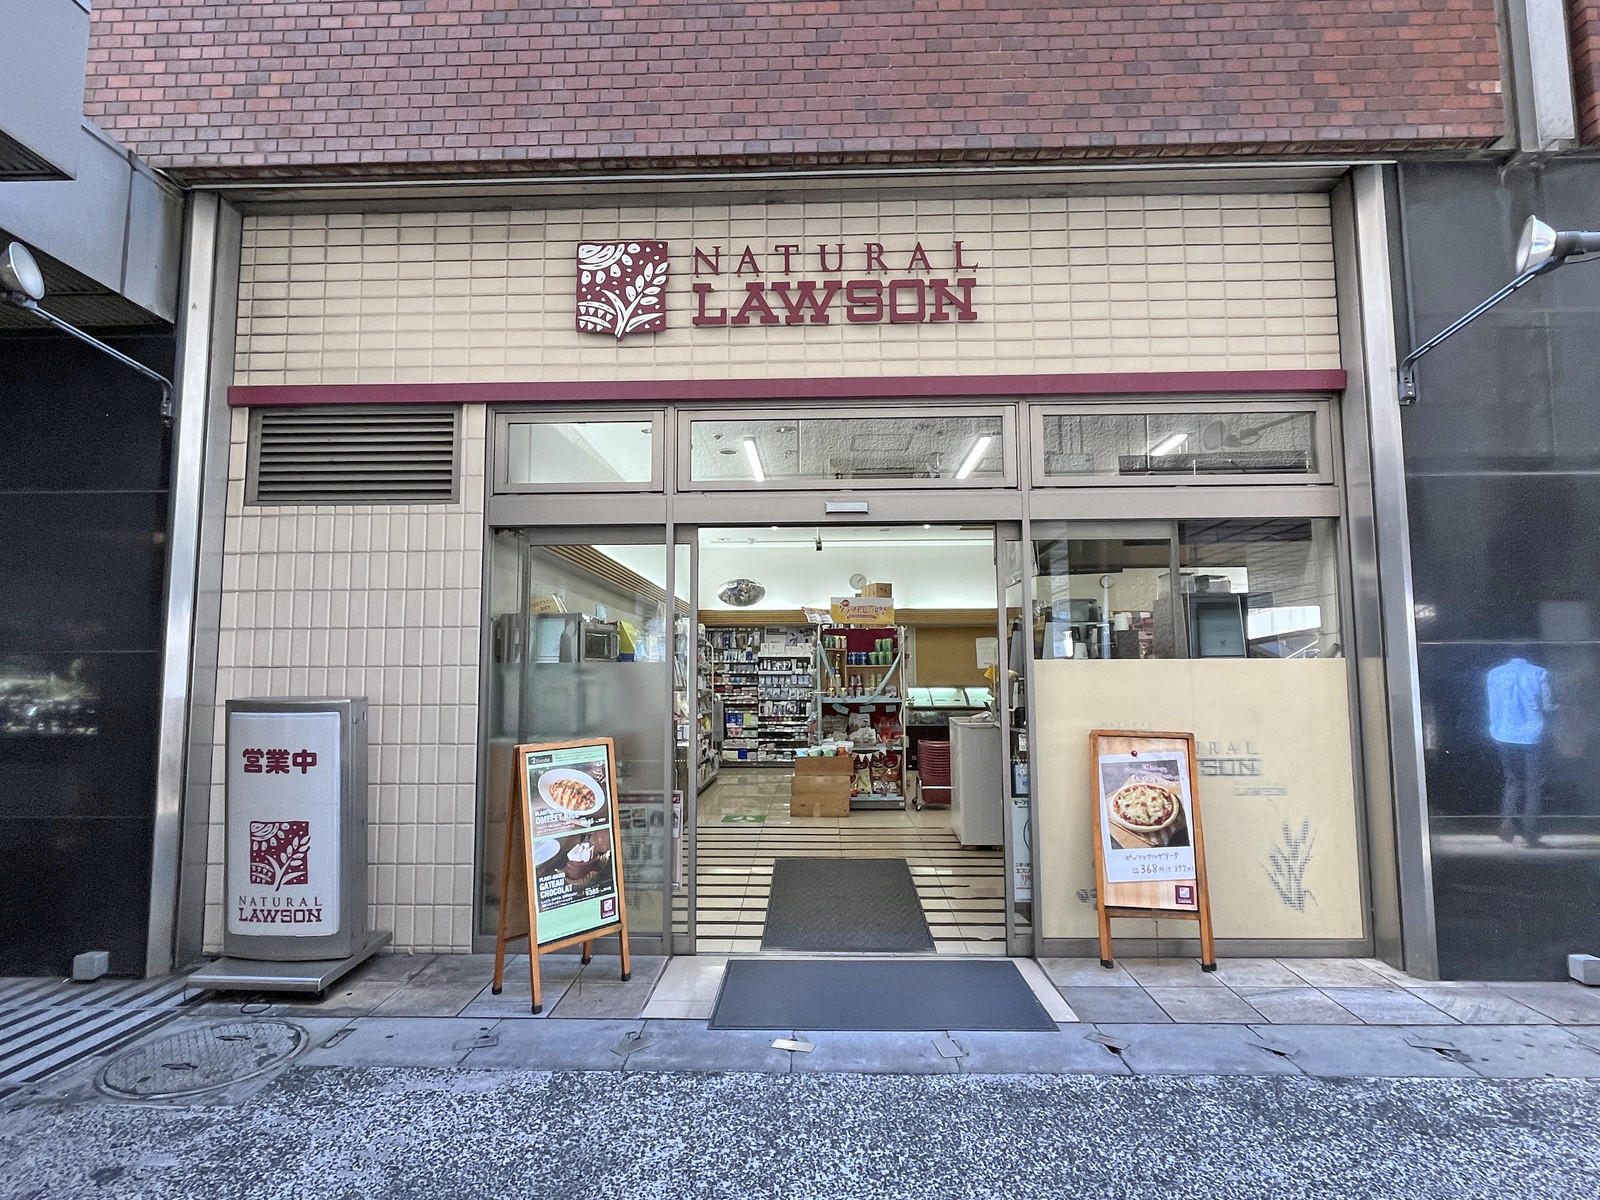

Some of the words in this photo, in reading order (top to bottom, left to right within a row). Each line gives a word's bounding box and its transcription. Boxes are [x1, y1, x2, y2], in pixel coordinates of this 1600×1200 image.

[694, 240, 978, 277] NATURAL
[692, 278, 978, 326] LAWSON
[242, 748, 318, 775] 営業中
[535, 813, 562, 825] OMELET
[540, 878, 565, 891] GATEAU
[540, 884, 573, 899] CHOCOLAT
[238, 895, 323, 907] NATURAL
[238, 907, 322, 924] LAWSON
